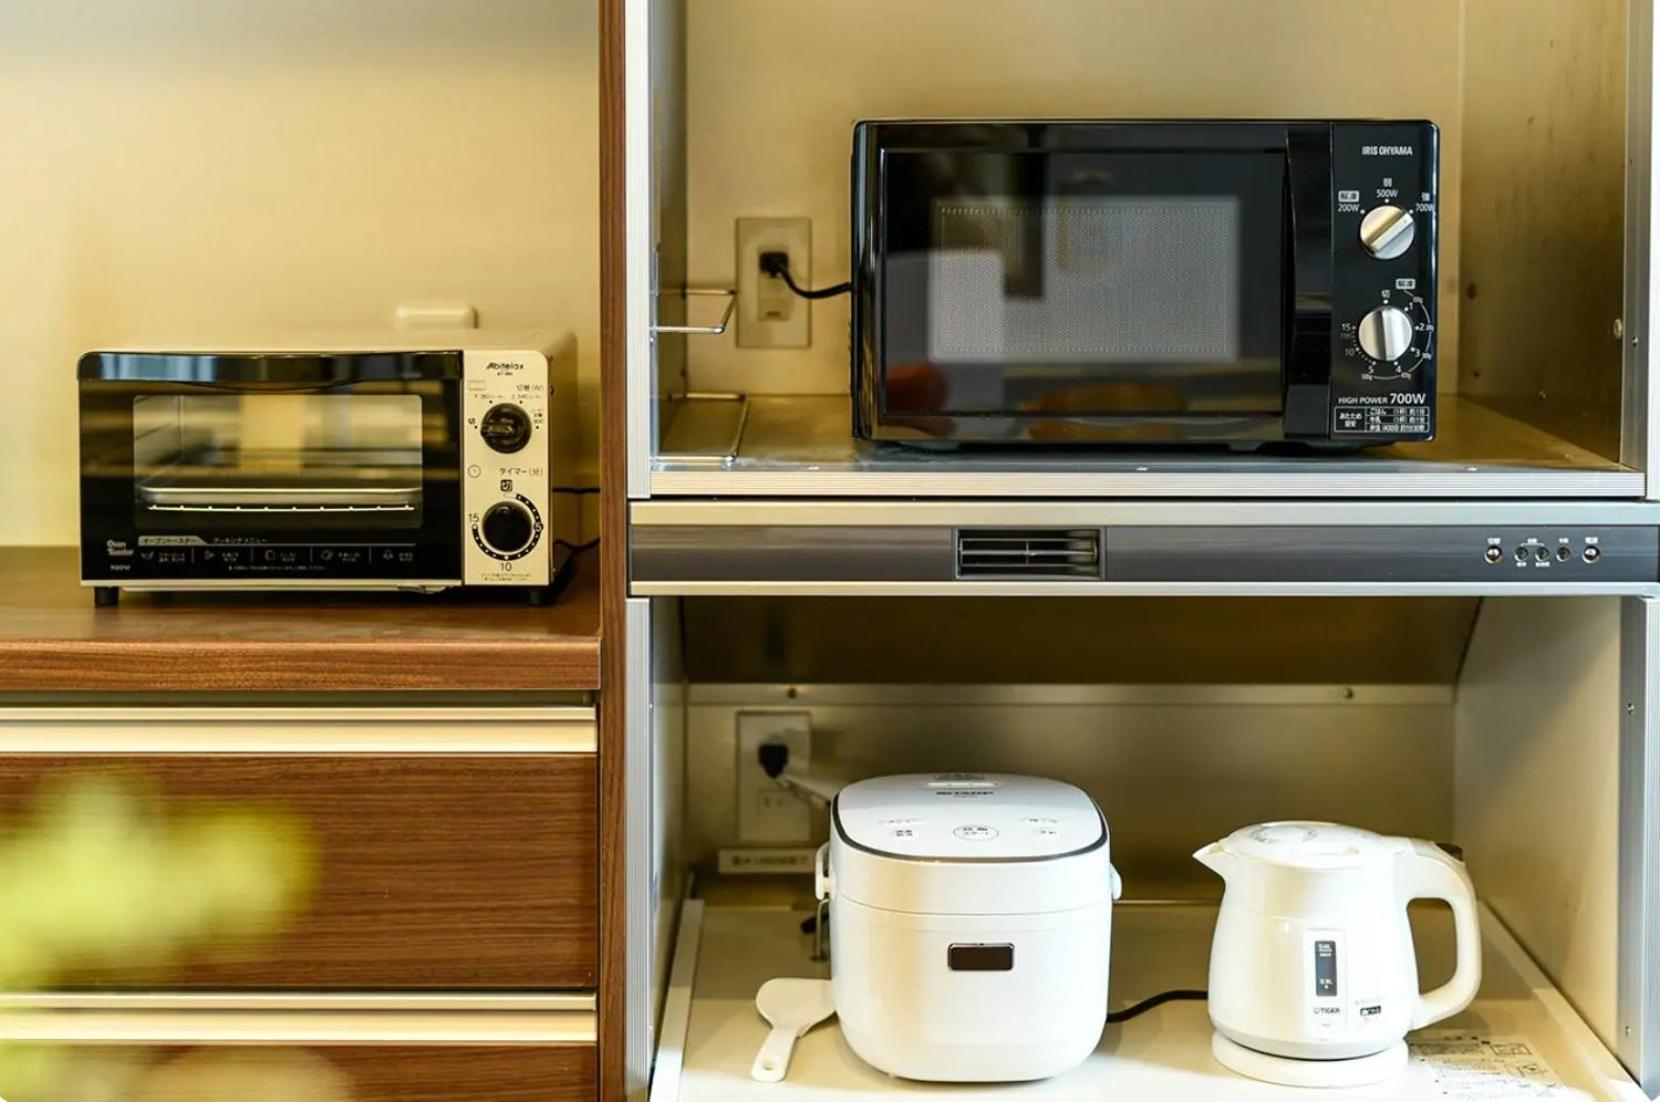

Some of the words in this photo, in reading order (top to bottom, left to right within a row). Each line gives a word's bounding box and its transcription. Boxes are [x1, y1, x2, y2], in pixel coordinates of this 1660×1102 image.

[1362, 146, 1378, 155] IRIS
[1379, 146, 1413, 155] OHYAMA
[1376, 189, 1398, 198] 500W
[1338, 203, 1360, 212] 200W
[1409, 302, 1414, 310] 1
[1341, 323, 1351, 331] 15
[1419, 322, 1425, 331] 2
[1345, 348, 1355, 356] 10
[1415, 349, 1421, 357] 3
[1368, 365, 1375, 374] 5
[1395, 365, 1402, 373] 4
[1338, 396, 1358, 404] HIGH
[1360, 396, 1388, 404] POWER
[1390, 393, 1426, 404] 700W
[469, 513, 480, 522] 15
[500, 562, 512, 571] 10
[1320, 1007, 1340, 1015] TIGER
